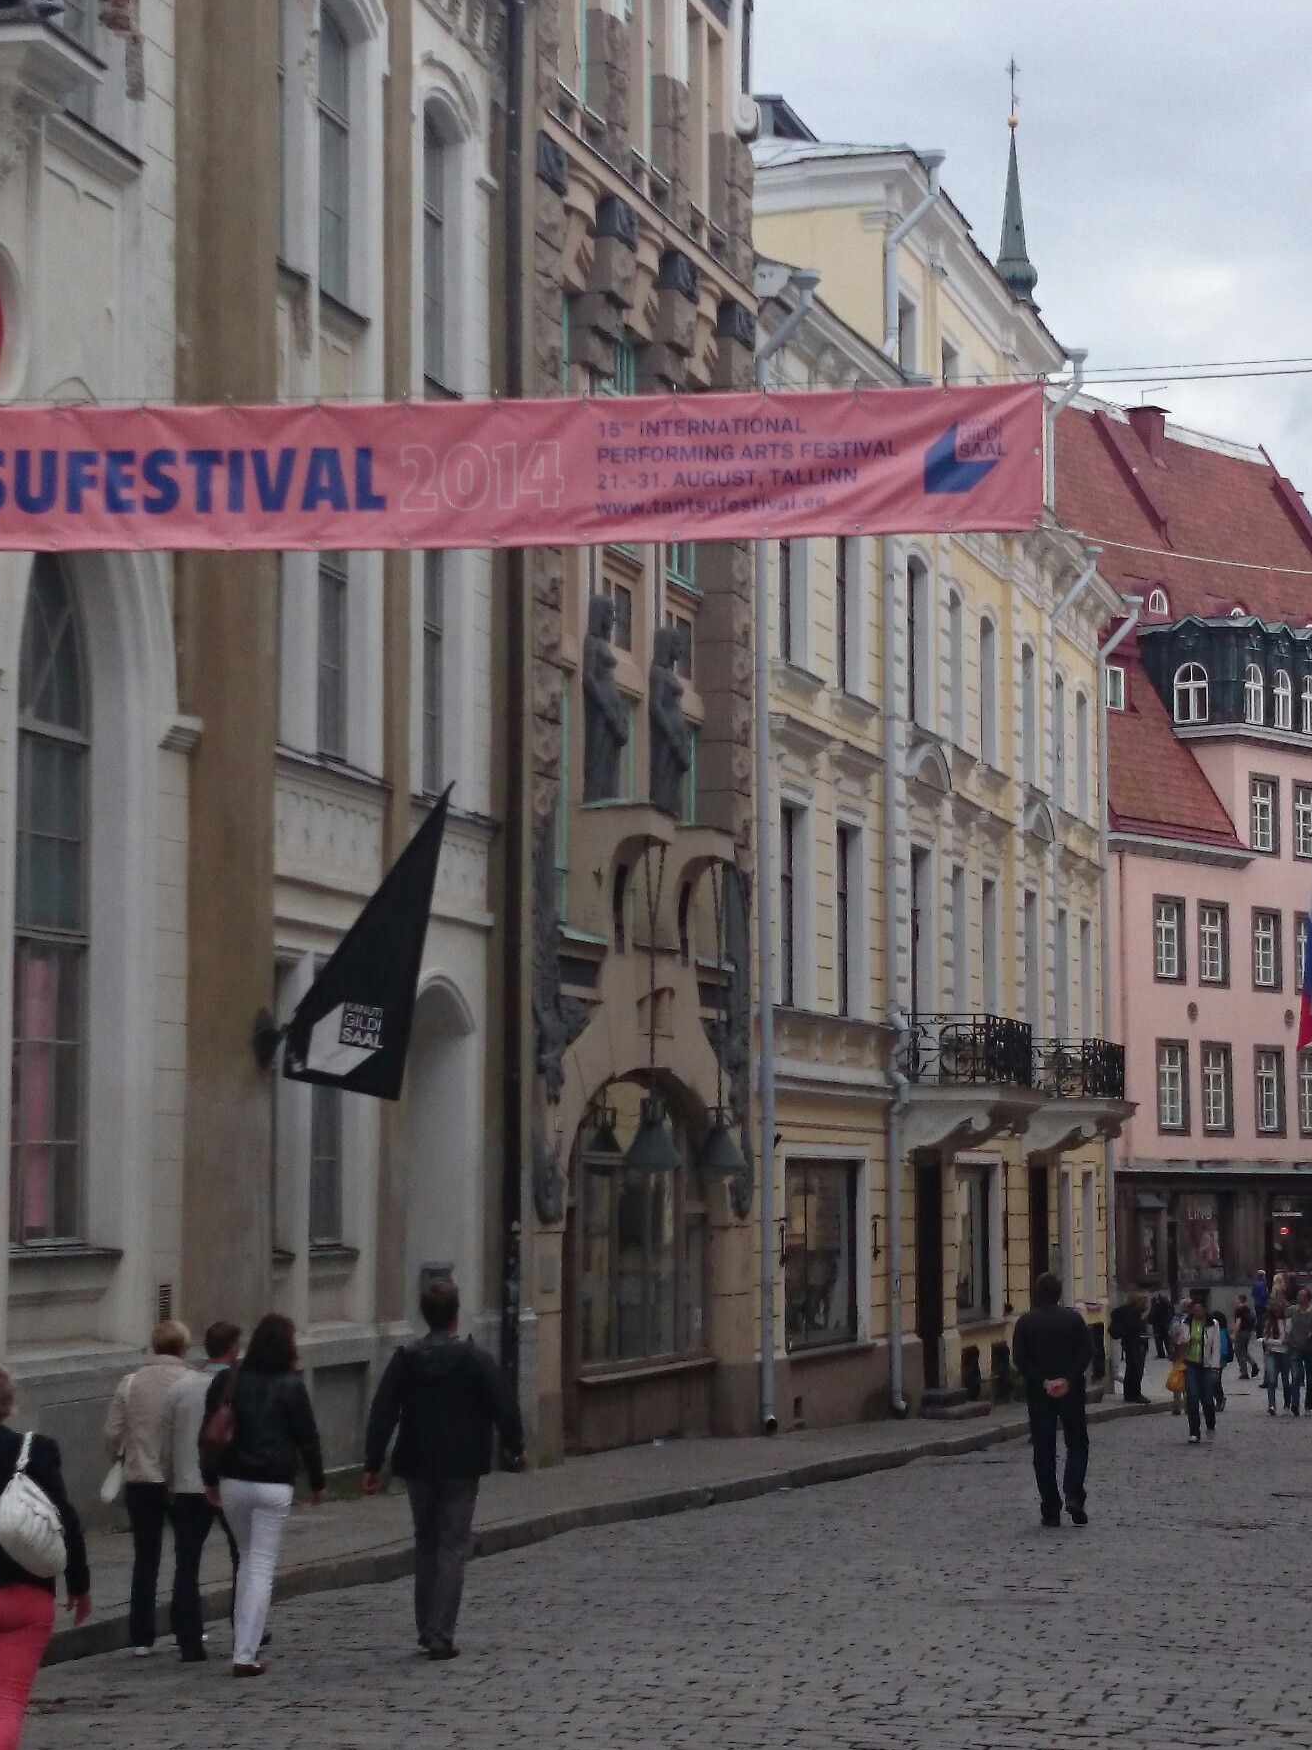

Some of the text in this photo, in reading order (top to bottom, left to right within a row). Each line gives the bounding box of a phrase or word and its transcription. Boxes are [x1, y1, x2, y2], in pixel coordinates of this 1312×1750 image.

[639, 417, 807, 438] INTERNATIONAL
[597, 440, 899, 464] PERFORMING ARTS FESTIVAL
[399, 441, 565, 512] 2014
[673, 469, 763, 490] AUGUST,
[769, 468, 858, 486] TALLINN
[596, 494, 826, 516] www.tantsufestival.ee
[344, 1013, 382, 1032] GILDI
[340, 1027, 384, 1049] SAAL
